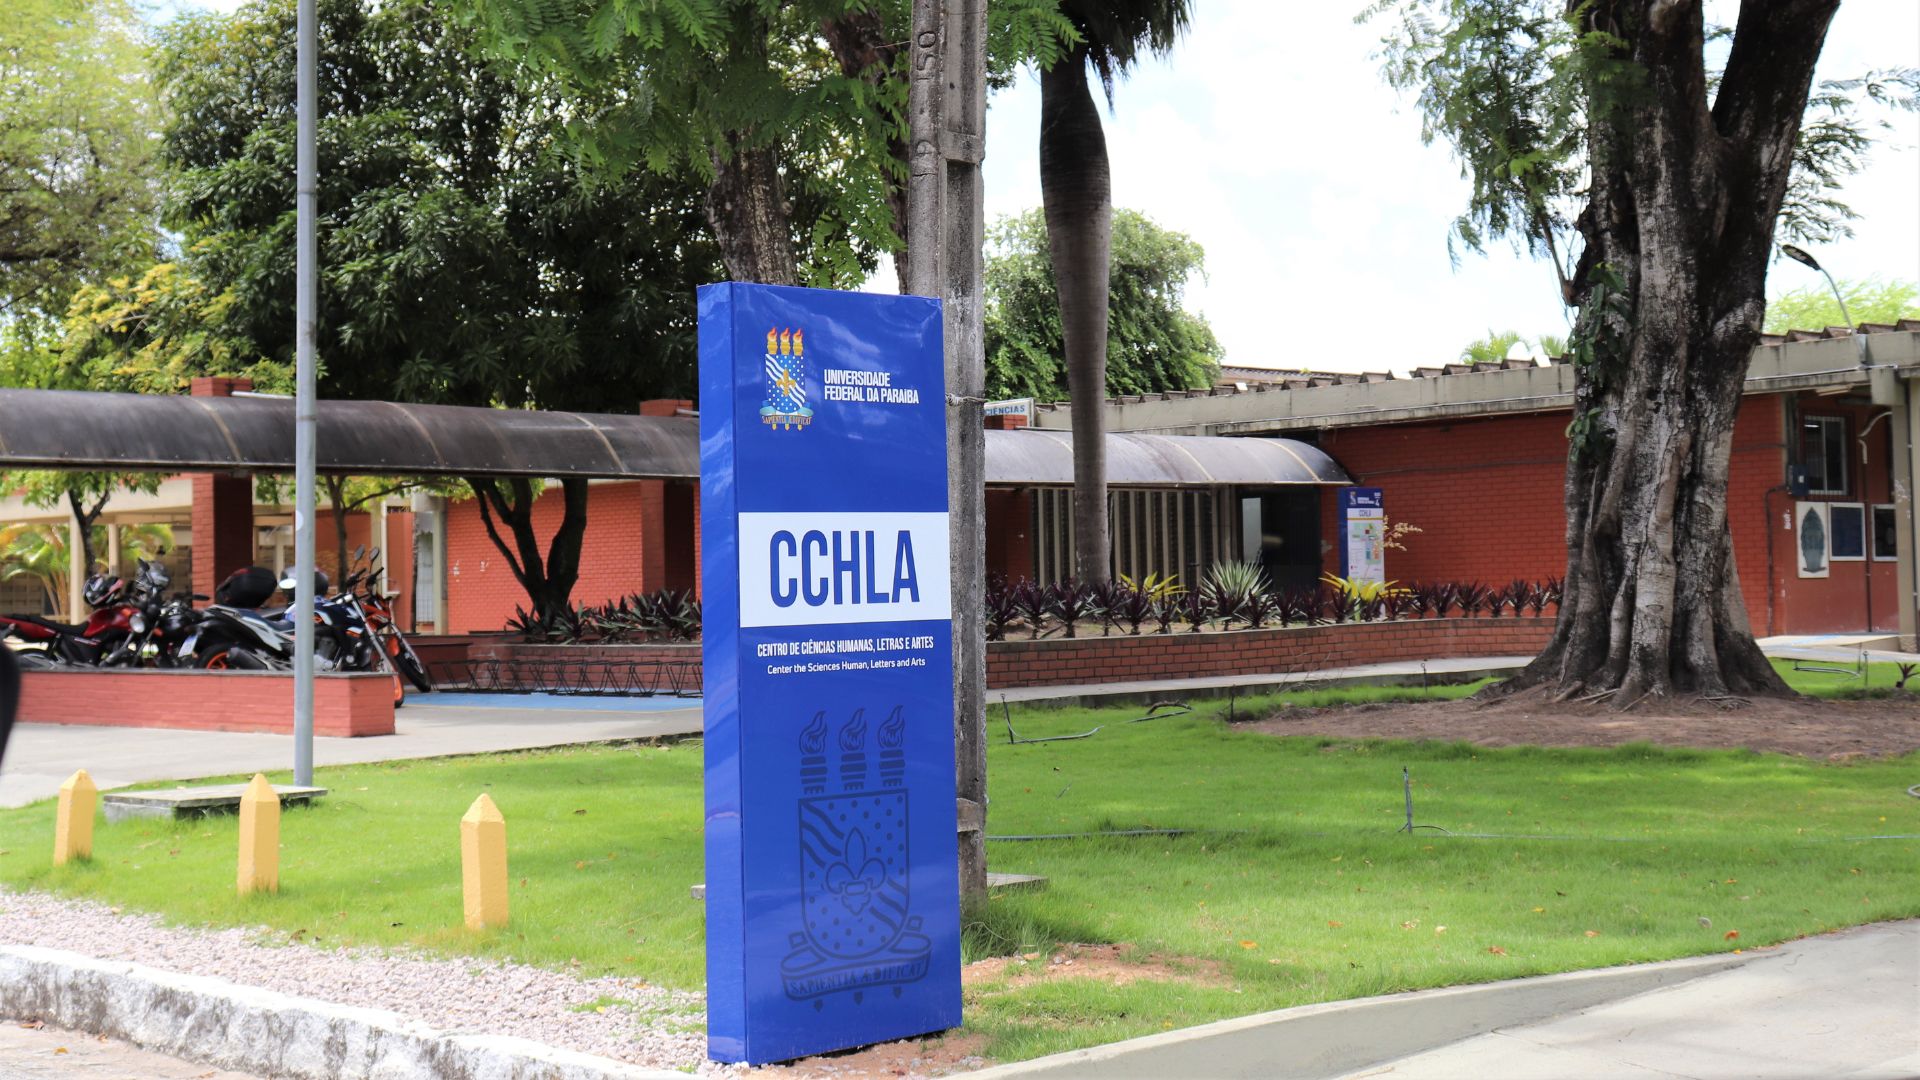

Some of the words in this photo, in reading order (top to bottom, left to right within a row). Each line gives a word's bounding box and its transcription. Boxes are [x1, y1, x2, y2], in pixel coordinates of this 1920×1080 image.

[824, 369, 891, 387] UNIVERSIDADE
[824, 385, 865, 401] FEDERAL
[867, 388, 879, 402] DA
[881, 388, 919, 404] PARAÍBA
[769, 530, 920, 608] CCHLA
[757, 643, 788, 657] CENTRO
[789, 642, 800, 656] DE
[801, 638, 835, 655] CIÊNCIAS
[837, 639, 876, 653] HUMANAS,
[877, 638, 904, 651] LETRAS
[905, 637, 910, 650] E
[911, 636, 934, 649] ARTES
[767, 665, 793, 674] Center
[793, 664, 806, 673] the
[808, 662, 840, 672] Sciences
[841, 661, 869, 670] Human,
[870, 659, 895, 669] Letters
[896, 658, 910, 667] and
[911, 657, 926, 666] Arts
[790, 970, 857, 995] SAPIENTIA
